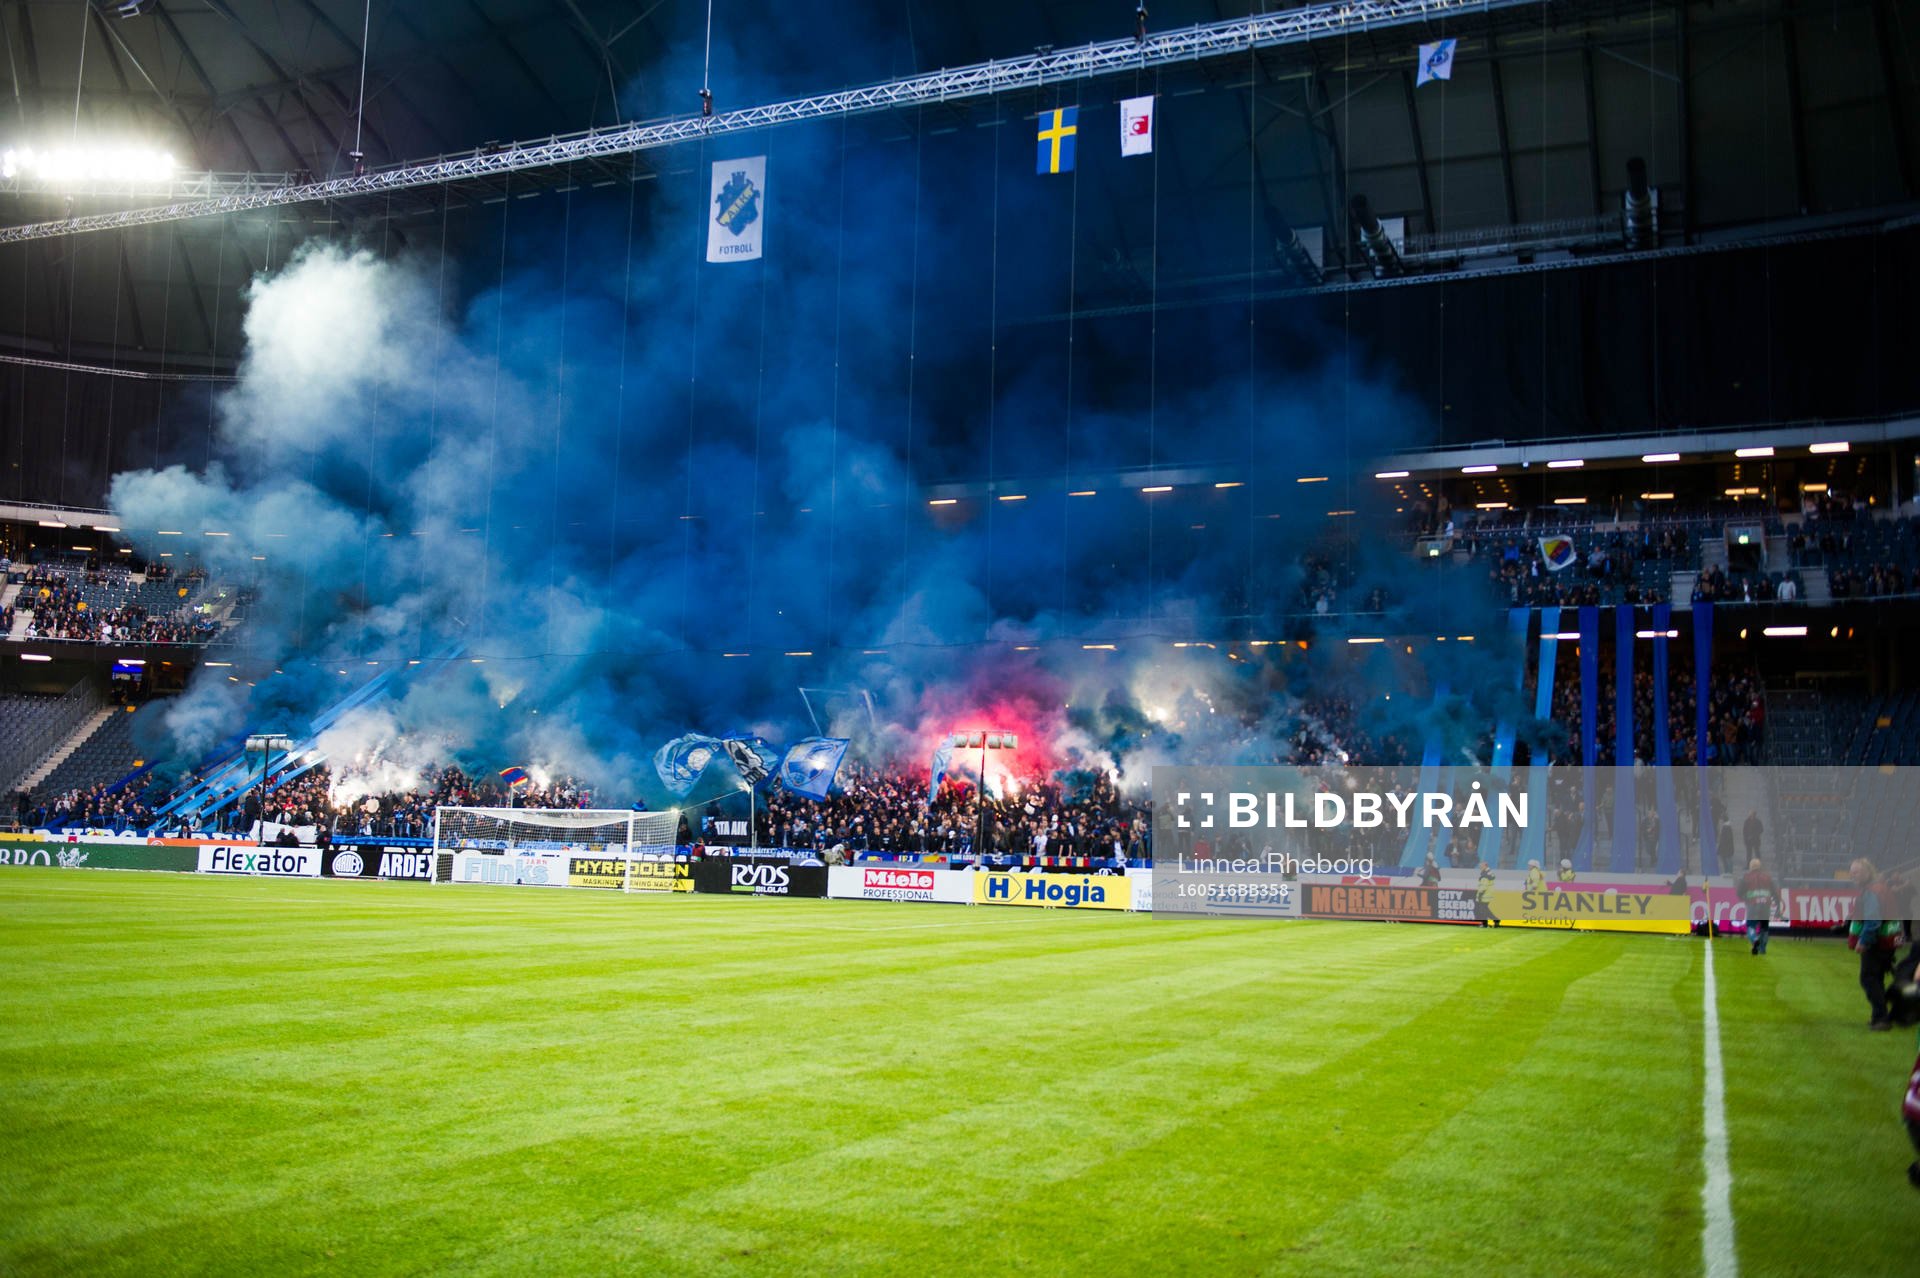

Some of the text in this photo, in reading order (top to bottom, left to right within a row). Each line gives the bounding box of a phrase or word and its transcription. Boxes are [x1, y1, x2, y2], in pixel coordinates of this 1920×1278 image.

[719, 244, 753, 254] FOTBOLL
[211, 847, 308, 873] Flexator
[379, 853, 434, 878] ARDEX
[464, 857, 550, 884] Flinks
[731, 864, 790, 887] RYDS
[865, 871, 933, 888] Miele
[863, 888, 934, 900] PROFESSIONAL
[1025, 878, 1105, 906] Hogia
[1437, 890, 1463, 900] CITY
[1437, 898, 1475, 910] EKERÖ
[1521, 891, 1653, 915] STANLEY
[1437, 909, 1476, 920] SOLNA
[1521, 912, 1577, 929] Security
